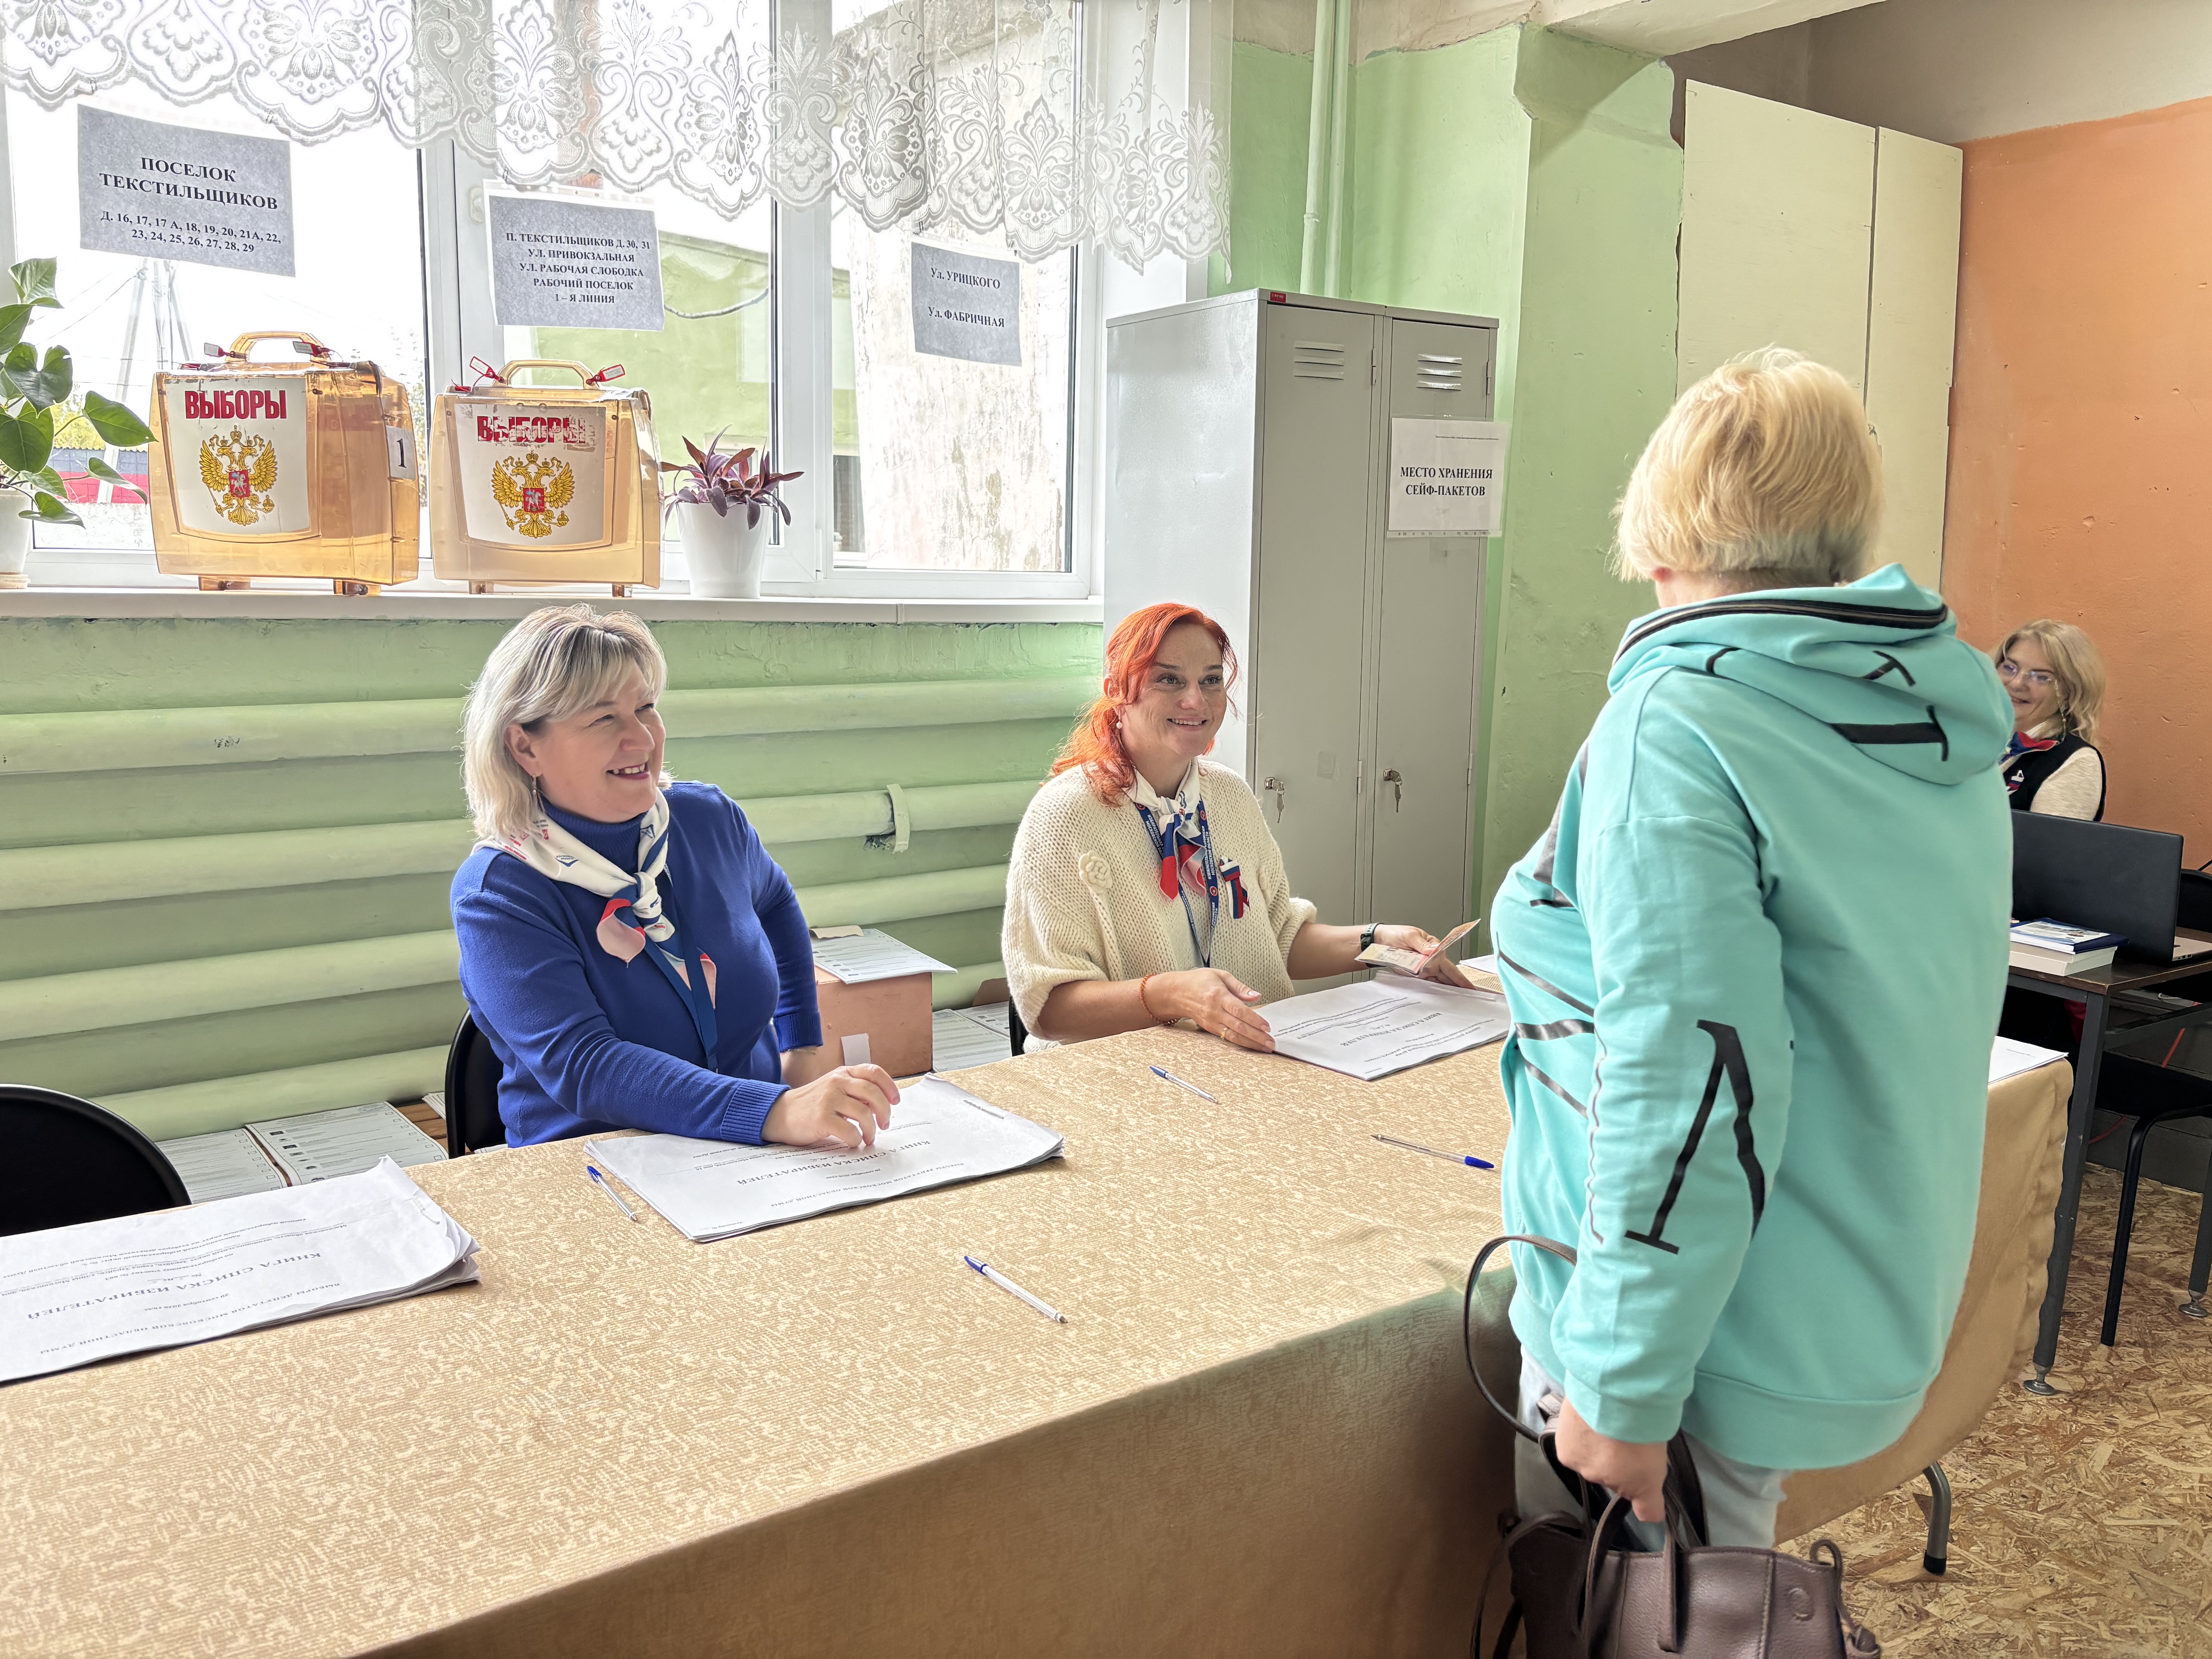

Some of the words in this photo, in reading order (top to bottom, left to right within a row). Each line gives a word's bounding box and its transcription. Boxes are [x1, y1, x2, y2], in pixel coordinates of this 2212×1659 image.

[140, 156, 236, 182] ПОСЕЛОК
[99, 173, 278, 210] ТЕКСТИЛЬЩИКОВ
[100, 211, 113, 221] Д.
[117, 212, 133, 225] 16,
[136, 215, 151, 227] 17,
[155, 218, 167, 227] 17
[170, 221, 182, 231] А,
[186, 222, 201, 233] 18,
[204, 225, 219, 235] 19,
[222, 227, 237, 238] 20,
[240, 229, 264, 242] 21А,
[266, 233, 281, 244] 22,
[131, 229, 147, 241] 23,
[151, 232, 166, 244] 24,
[169, 234, 185, 246] 25,
[187, 236, 203, 248] 26,
[206, 239, 222, 250] 27,
[225, 240, 240, 252] 28,
[242, 242, 254, 253] 29
[506, 232, 517, 241] П.
[519, 233, 614, 247] ТЕКСТИЛЬЩИКОВ
[616, 239, 625, 249] Д.
[626, 240, 638, 250] 30,
[641, 241, 650, 250] 31
[527, 249, 546, 258] УЛ.
[548, 250, 635, 262] ПРИВОКЗАЛЬНАЯ
[519, 263, 538, 272] УЛ.
[540, 264, 588, 274] РАБОЧАЯ
[591, 266, 644, 277] СЛОБОДКА
[931, 267, 945, 280] Ул.
[946, 270, 1001, 290] УРИЦКОГО
[533, 277, 582, 288] РАБОЧИЙ
[586, 280, 634, 290] ПОСЕЛОК
[555, 294, 559, 302] 1
[569, 294, 576, 302] Я
[579, 294, 615, 304] ЛИНИЯ
[928, 306, 943, 318] Ул.
[944, 309, 1005, 328] ФАБРИЧНАЯ
[184, 389, 287, 420] ВЫБОРЫ
[477, 415, 586, 444] ВЫБОРЫ
[398, 438, 407, 469] 1
[1400, 467, 1436, 478] МЕСТО
[1438, 467, 1493, 479] ХРАНЕНИЯ
[1405, 482, 1486, 496] СЕЙФ-ПАКЕТОВ
[888, 1140, 930, 1153] КНИГА
[833, 1152, 886, 1166] СПИСКА
[737, 1163, 831, 1185] ИЗБИРАТЕЛЕЙ
[259, 1252, 321, 1268] КНИГА
[175, 1267, 253, 1290] СПИСКА
[296, 1283, 340, 1295] ВЫБОРЫ
[27, 1287, 169, 1320] ИЗБИРАТЕЛЕЙ
[231, 1293, 292, 1313] ДЕПУТАТОВ
[152, 1312, 228, 1329] МОСКОВСКОЙ
[79, 1327, 148, 1345] ОБЛАСТНОЙ
[40, 1343, 75, 1354] ДУМЫ
